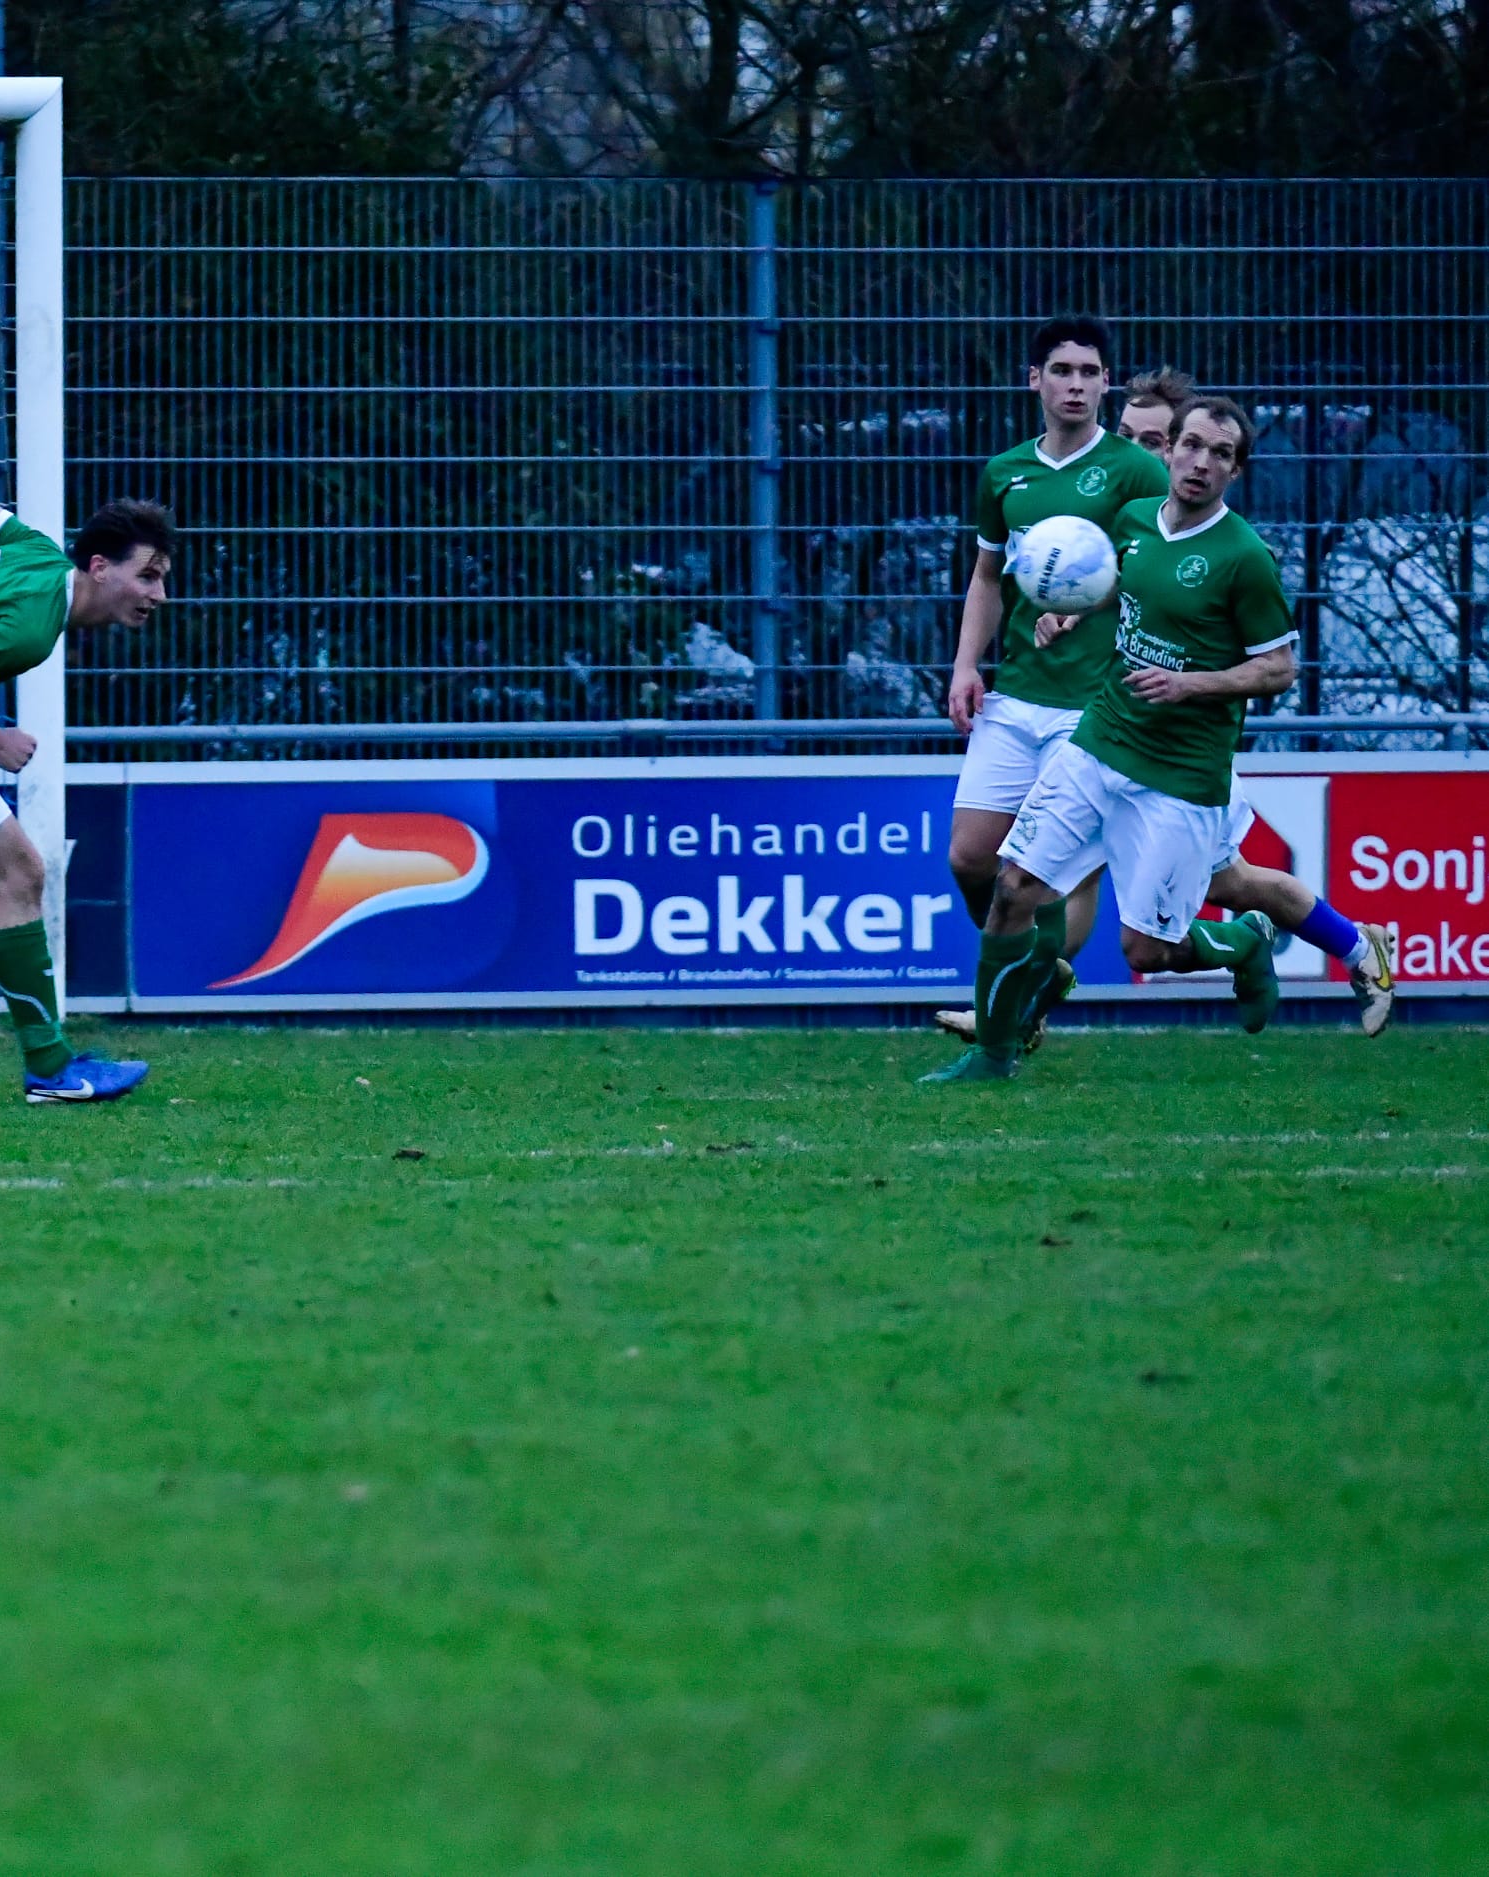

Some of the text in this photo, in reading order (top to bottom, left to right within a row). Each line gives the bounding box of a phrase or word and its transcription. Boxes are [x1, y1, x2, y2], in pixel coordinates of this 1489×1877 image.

[572, 811, 931, 858] Oliehandel
[1349, 834, 1489, 905] Sonj
[573, 874, 953, 956] Dekker
[906, 965, 959, 979] Gassen
